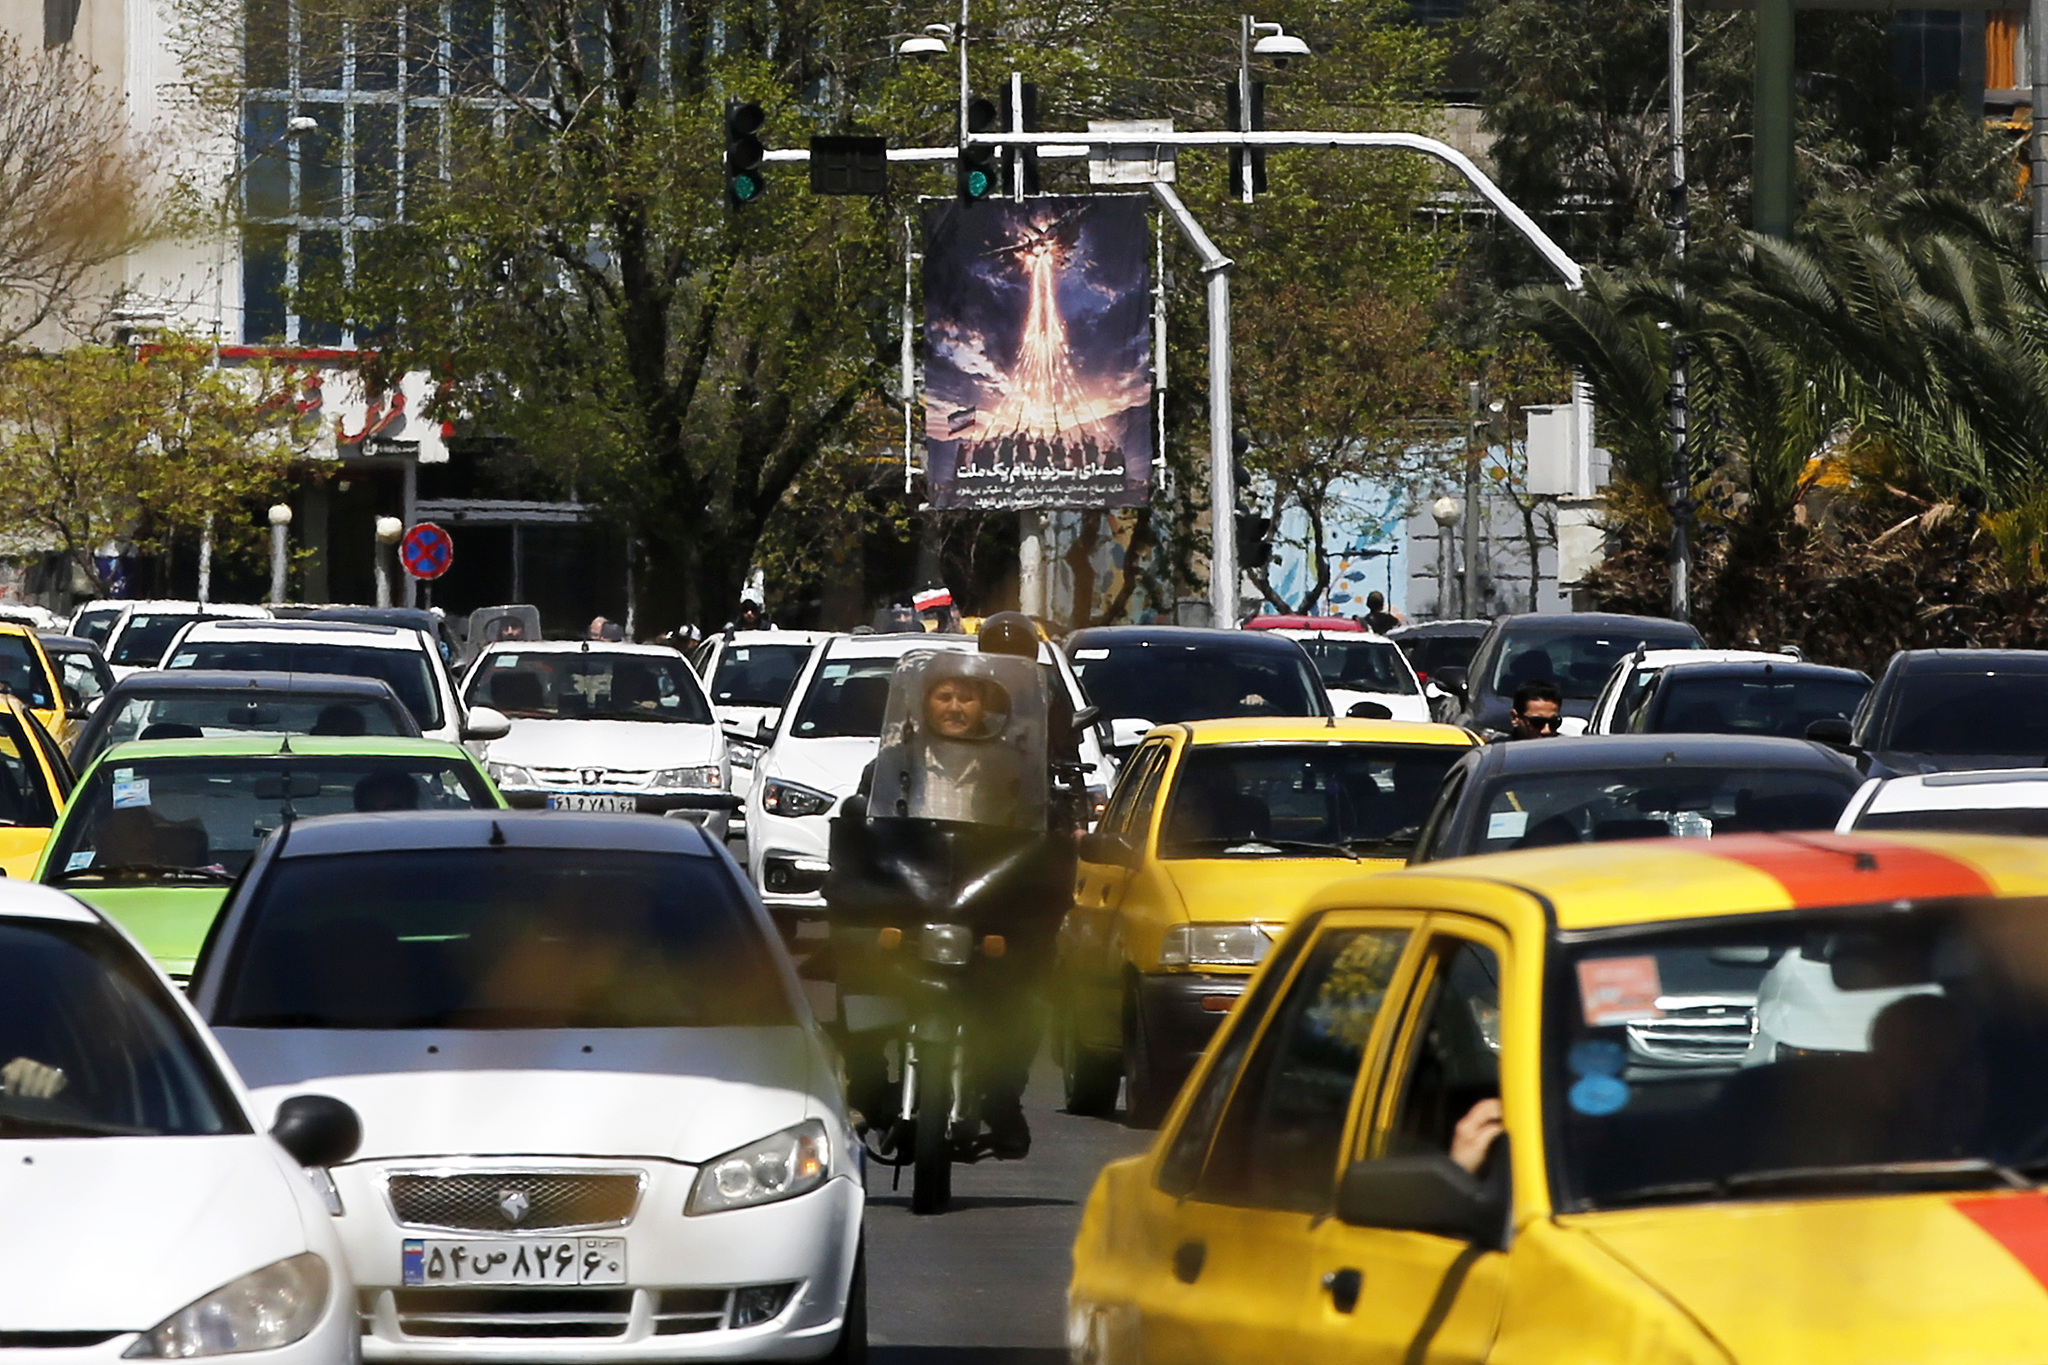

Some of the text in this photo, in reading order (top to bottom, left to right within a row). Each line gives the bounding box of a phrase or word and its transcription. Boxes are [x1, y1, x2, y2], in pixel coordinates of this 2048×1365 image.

[956, 462, 986, 478] ملت
[1079, 462, 1125, 481] صدای
[583, 1251, 619, 1280] ۶۰
